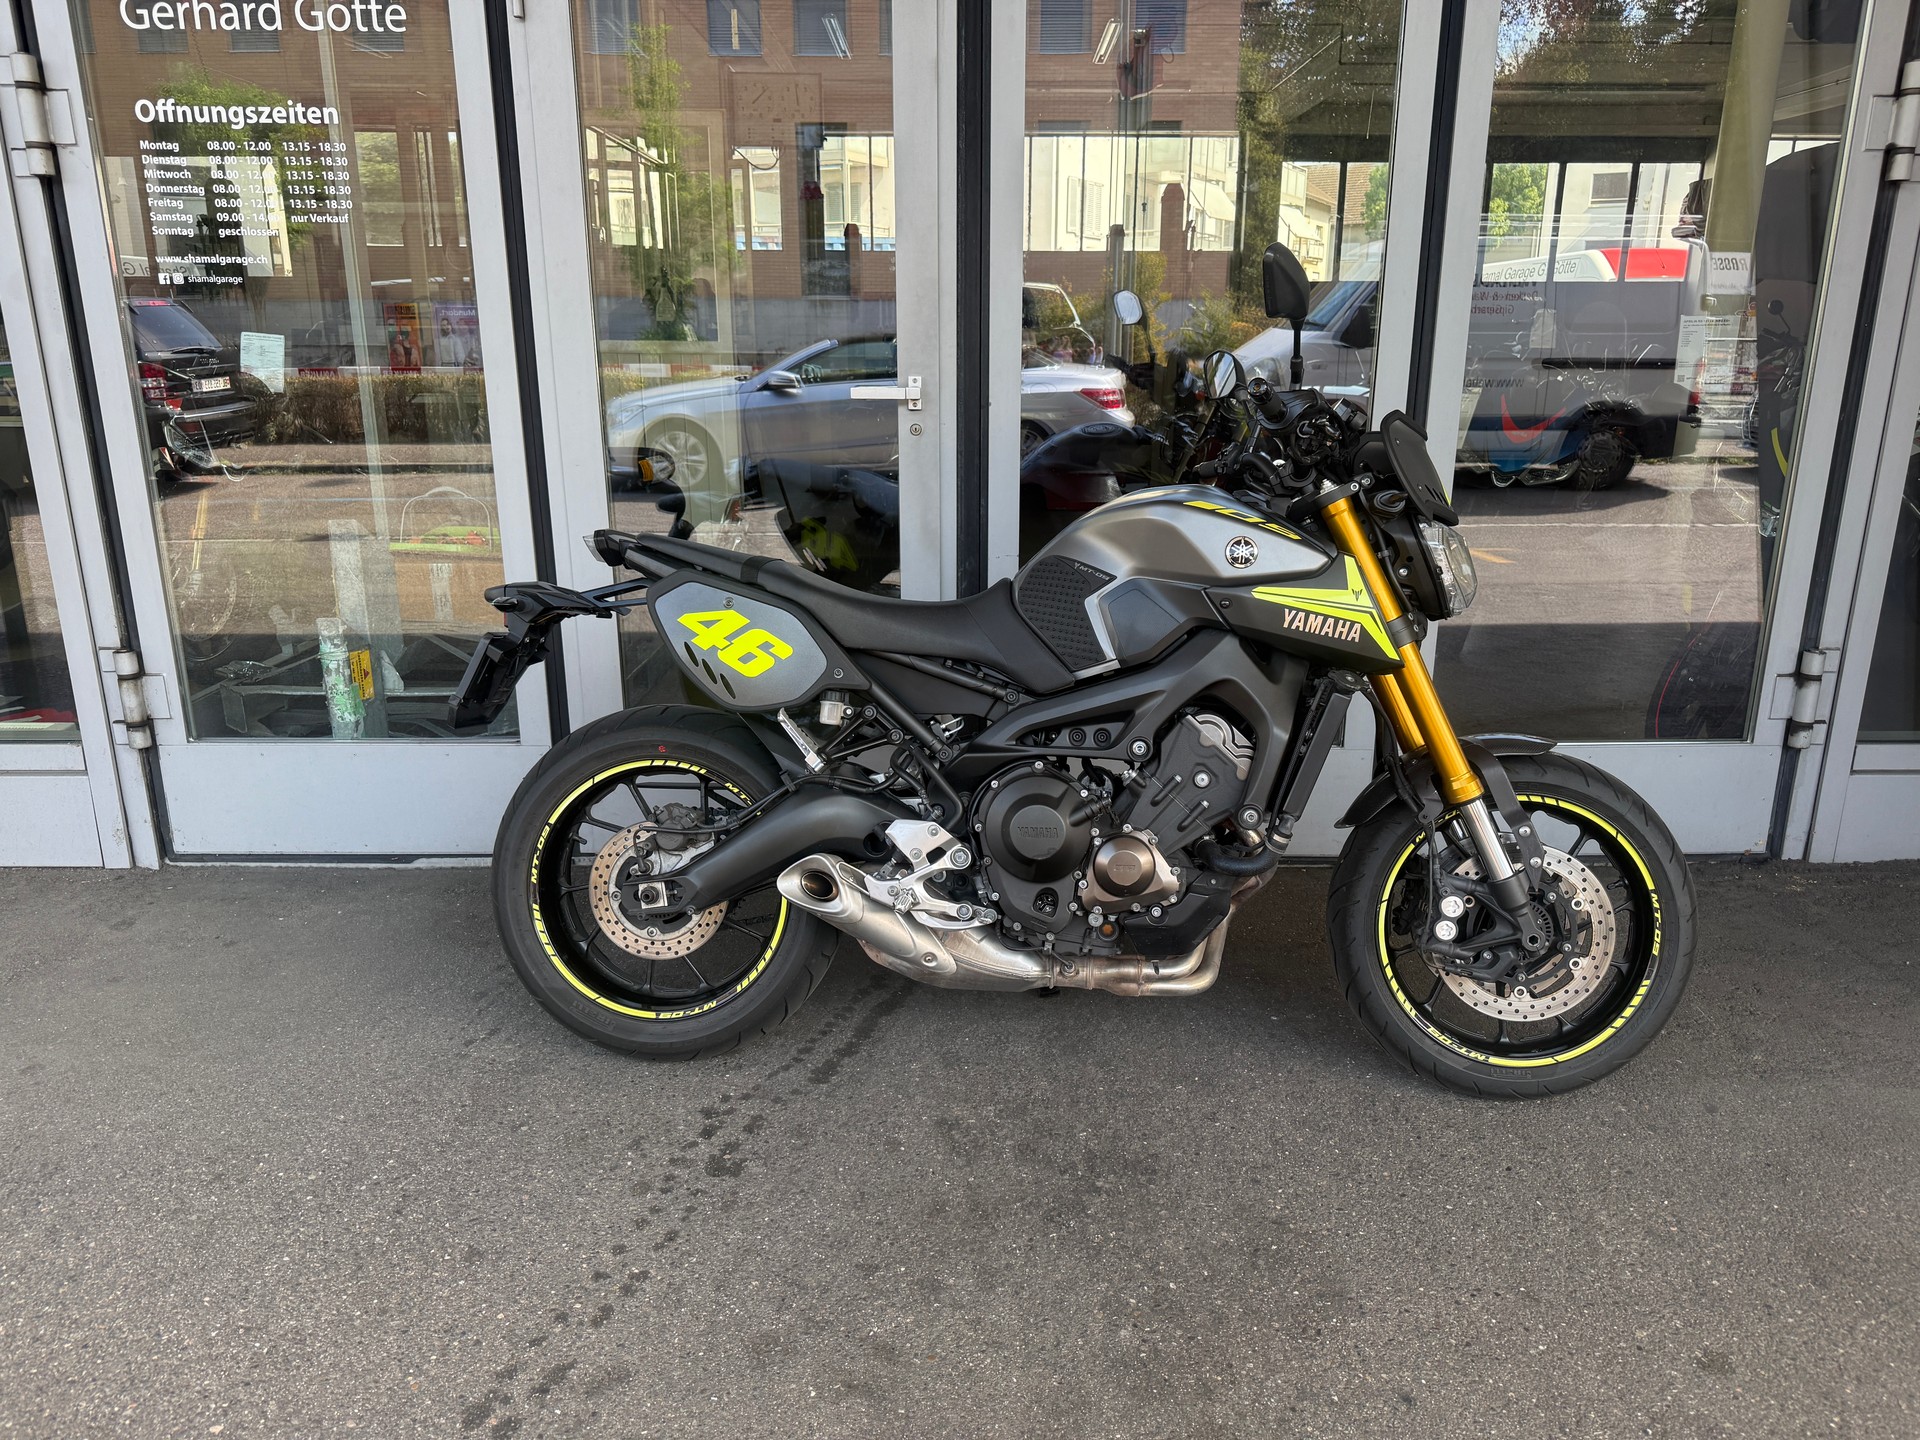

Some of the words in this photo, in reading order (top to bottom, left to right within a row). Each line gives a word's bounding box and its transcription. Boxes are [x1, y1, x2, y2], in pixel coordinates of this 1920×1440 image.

[119, 0, 283, 31] Gerhard
[140, 140, 179, 152] Montag
[207, 141, 235, 150] 08.00
[243, 142, 271, 150] 12.00
[282, 142, 310, 151] 13.15
[318, 142, 346, 151] 18.30
[141, 155, 187, 166] Dienstag
[209, 156, 237, 164] 08.00
[245, 156, 273, 165] 12.00
[284, 157, 312, 165] 13.15
[320, 157, 348, 166] 18.30
[144, 169, 191, 178] Mittwoch
[211, 170, 239, 179] 08.00
[286, 171, 314, 180] 13.15
[322, 171, 350, 180] 18.30
[145, 184, 205, 196] Donnerstag
[212, 184, 240, 193] 08.00
[288, 185, 315, 194] 13.15
[323, 186, 351, 195] 18.30
[148, 198, 183, 209] Freitag
[214, 199, 242, 207] 08.00
[290, 199, 317, 208] 13.15
[325, 200, 353, 209] 18.30
[150, 212, 193, 223] Samstag
[216, 213, 244, 221] 09.00
[309, 213, 349, 223] Verkauf
[152, 226, 194, 237] Sonntag
[218, 226, 279, 238] geschlossen
[155, 253, 268, 265] www.shamalgarage.ch
[187, 274, 243, 285] shamalgarage
[1283, 608, 1361, 643] YAMAHA
[677, 609, 794, 678] 46
[1016, 826, 1060, 839] YAMAHA
[1650, 892, 1662, 957] MT-09
[658, 1000, 717, 1019] MT-09
